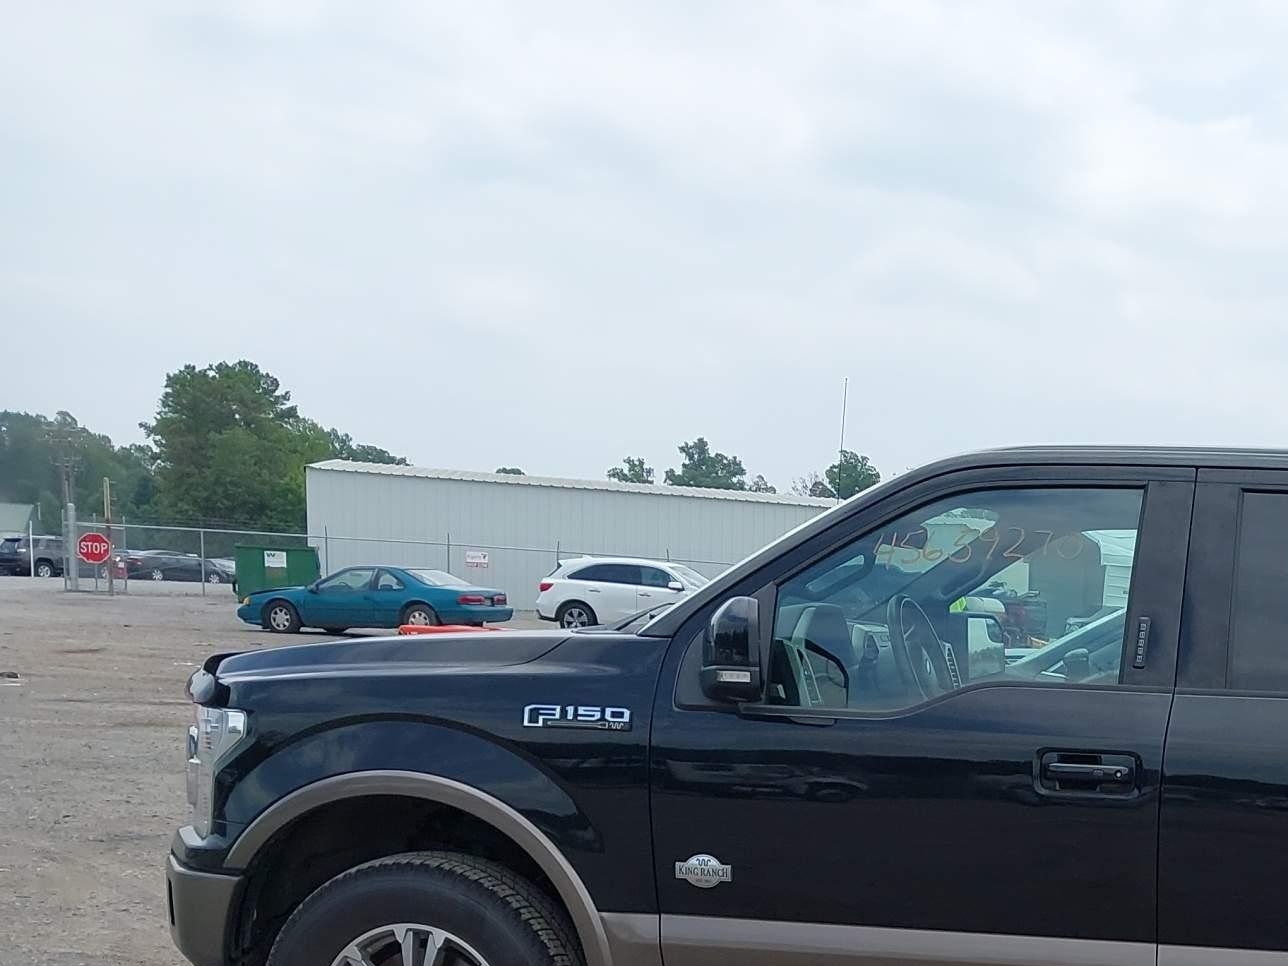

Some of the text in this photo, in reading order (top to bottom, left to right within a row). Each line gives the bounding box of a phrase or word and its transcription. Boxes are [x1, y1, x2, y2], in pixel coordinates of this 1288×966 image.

[80, 541, 108, 554] STOP
[678, 864, 728, 878] KING RANCH
